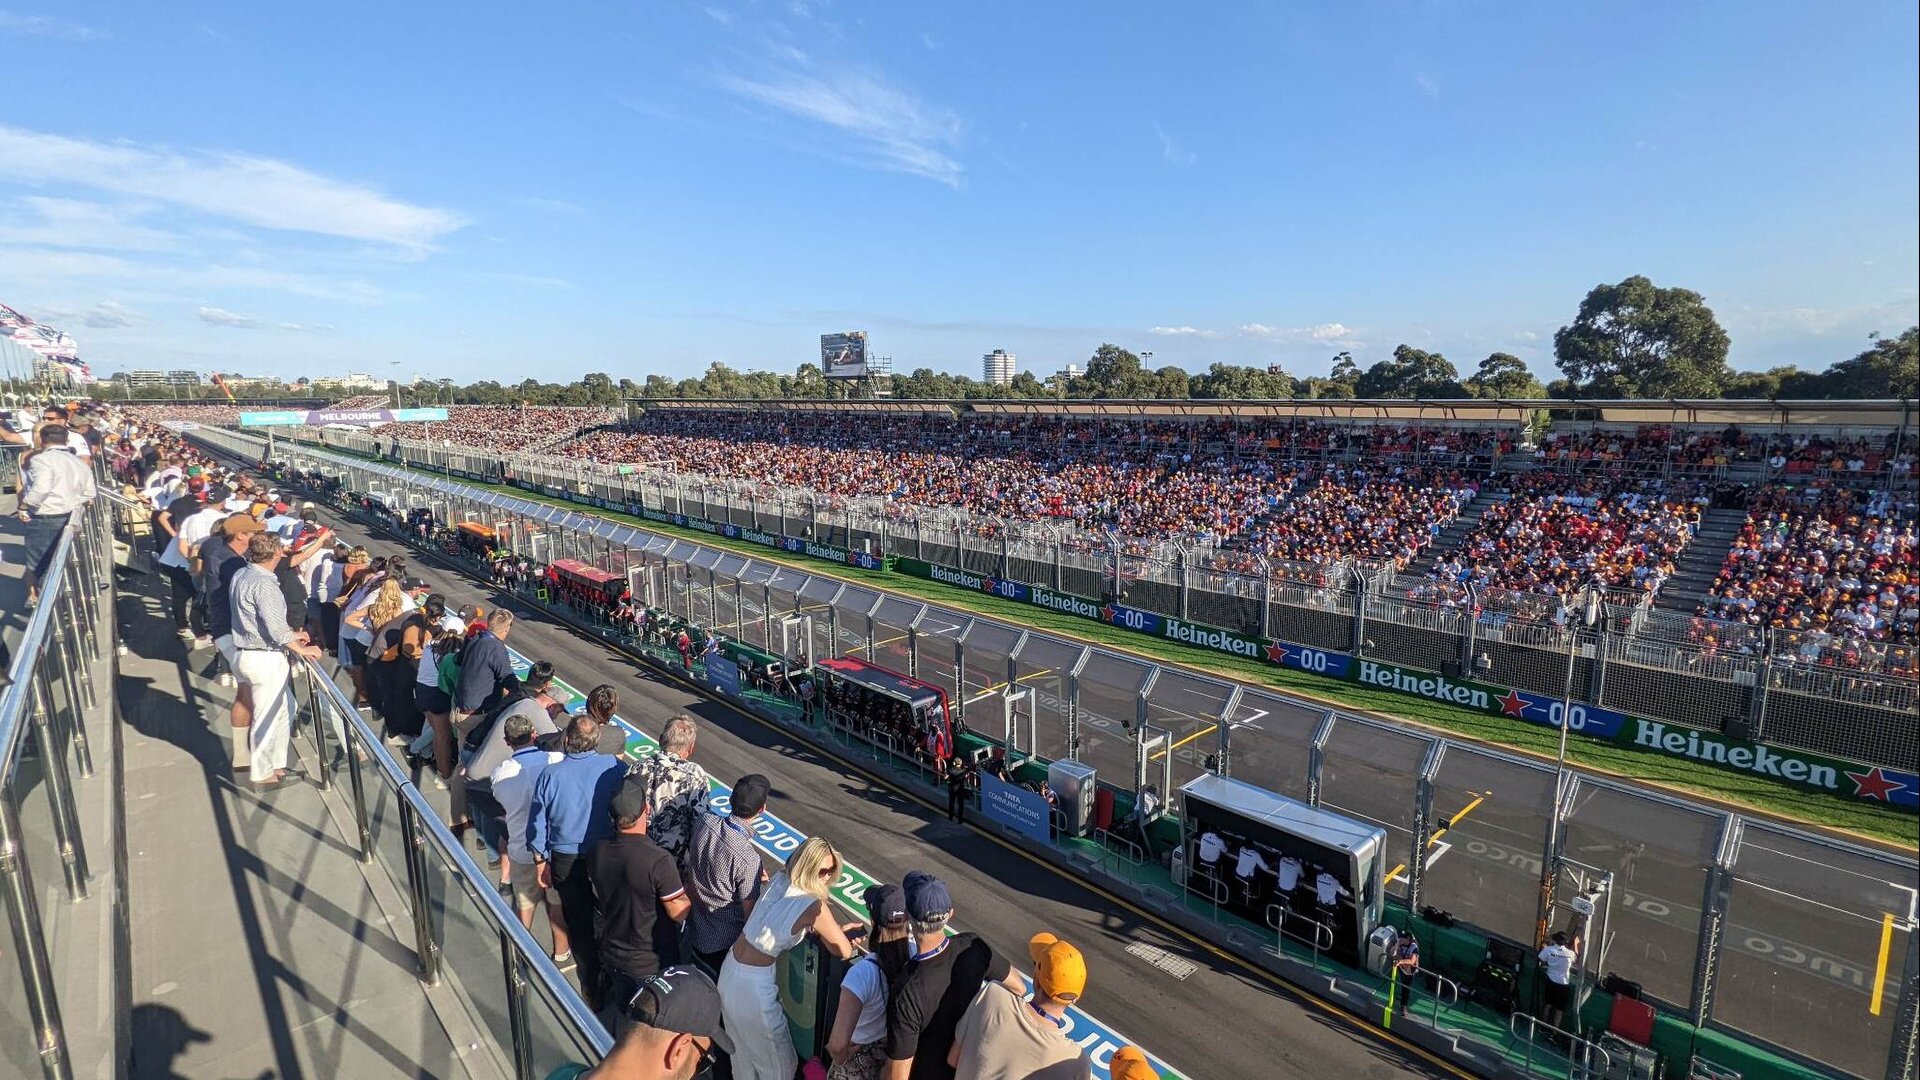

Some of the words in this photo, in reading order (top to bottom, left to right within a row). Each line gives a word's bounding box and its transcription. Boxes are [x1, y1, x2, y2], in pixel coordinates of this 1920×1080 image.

[319, 412, 381, 422] MELBOURNE
[742, 527, 775, 547] Heineken
[805, 541, 846, 562] Heineken
[930, 564, 982, 589] Heineken
[1031, 588, 1098, 618] Heineken
[1125, 610, 1144, 630] 0.0
[1165, 619, 1258, 657] Heineken
[1300, 649, 1326, 672] 0.0
[1358, 660, 1489, 710] Heineken
[1633, 718, 1838, 790] Heineken
[1003, 791, 1021, 804] TATA
